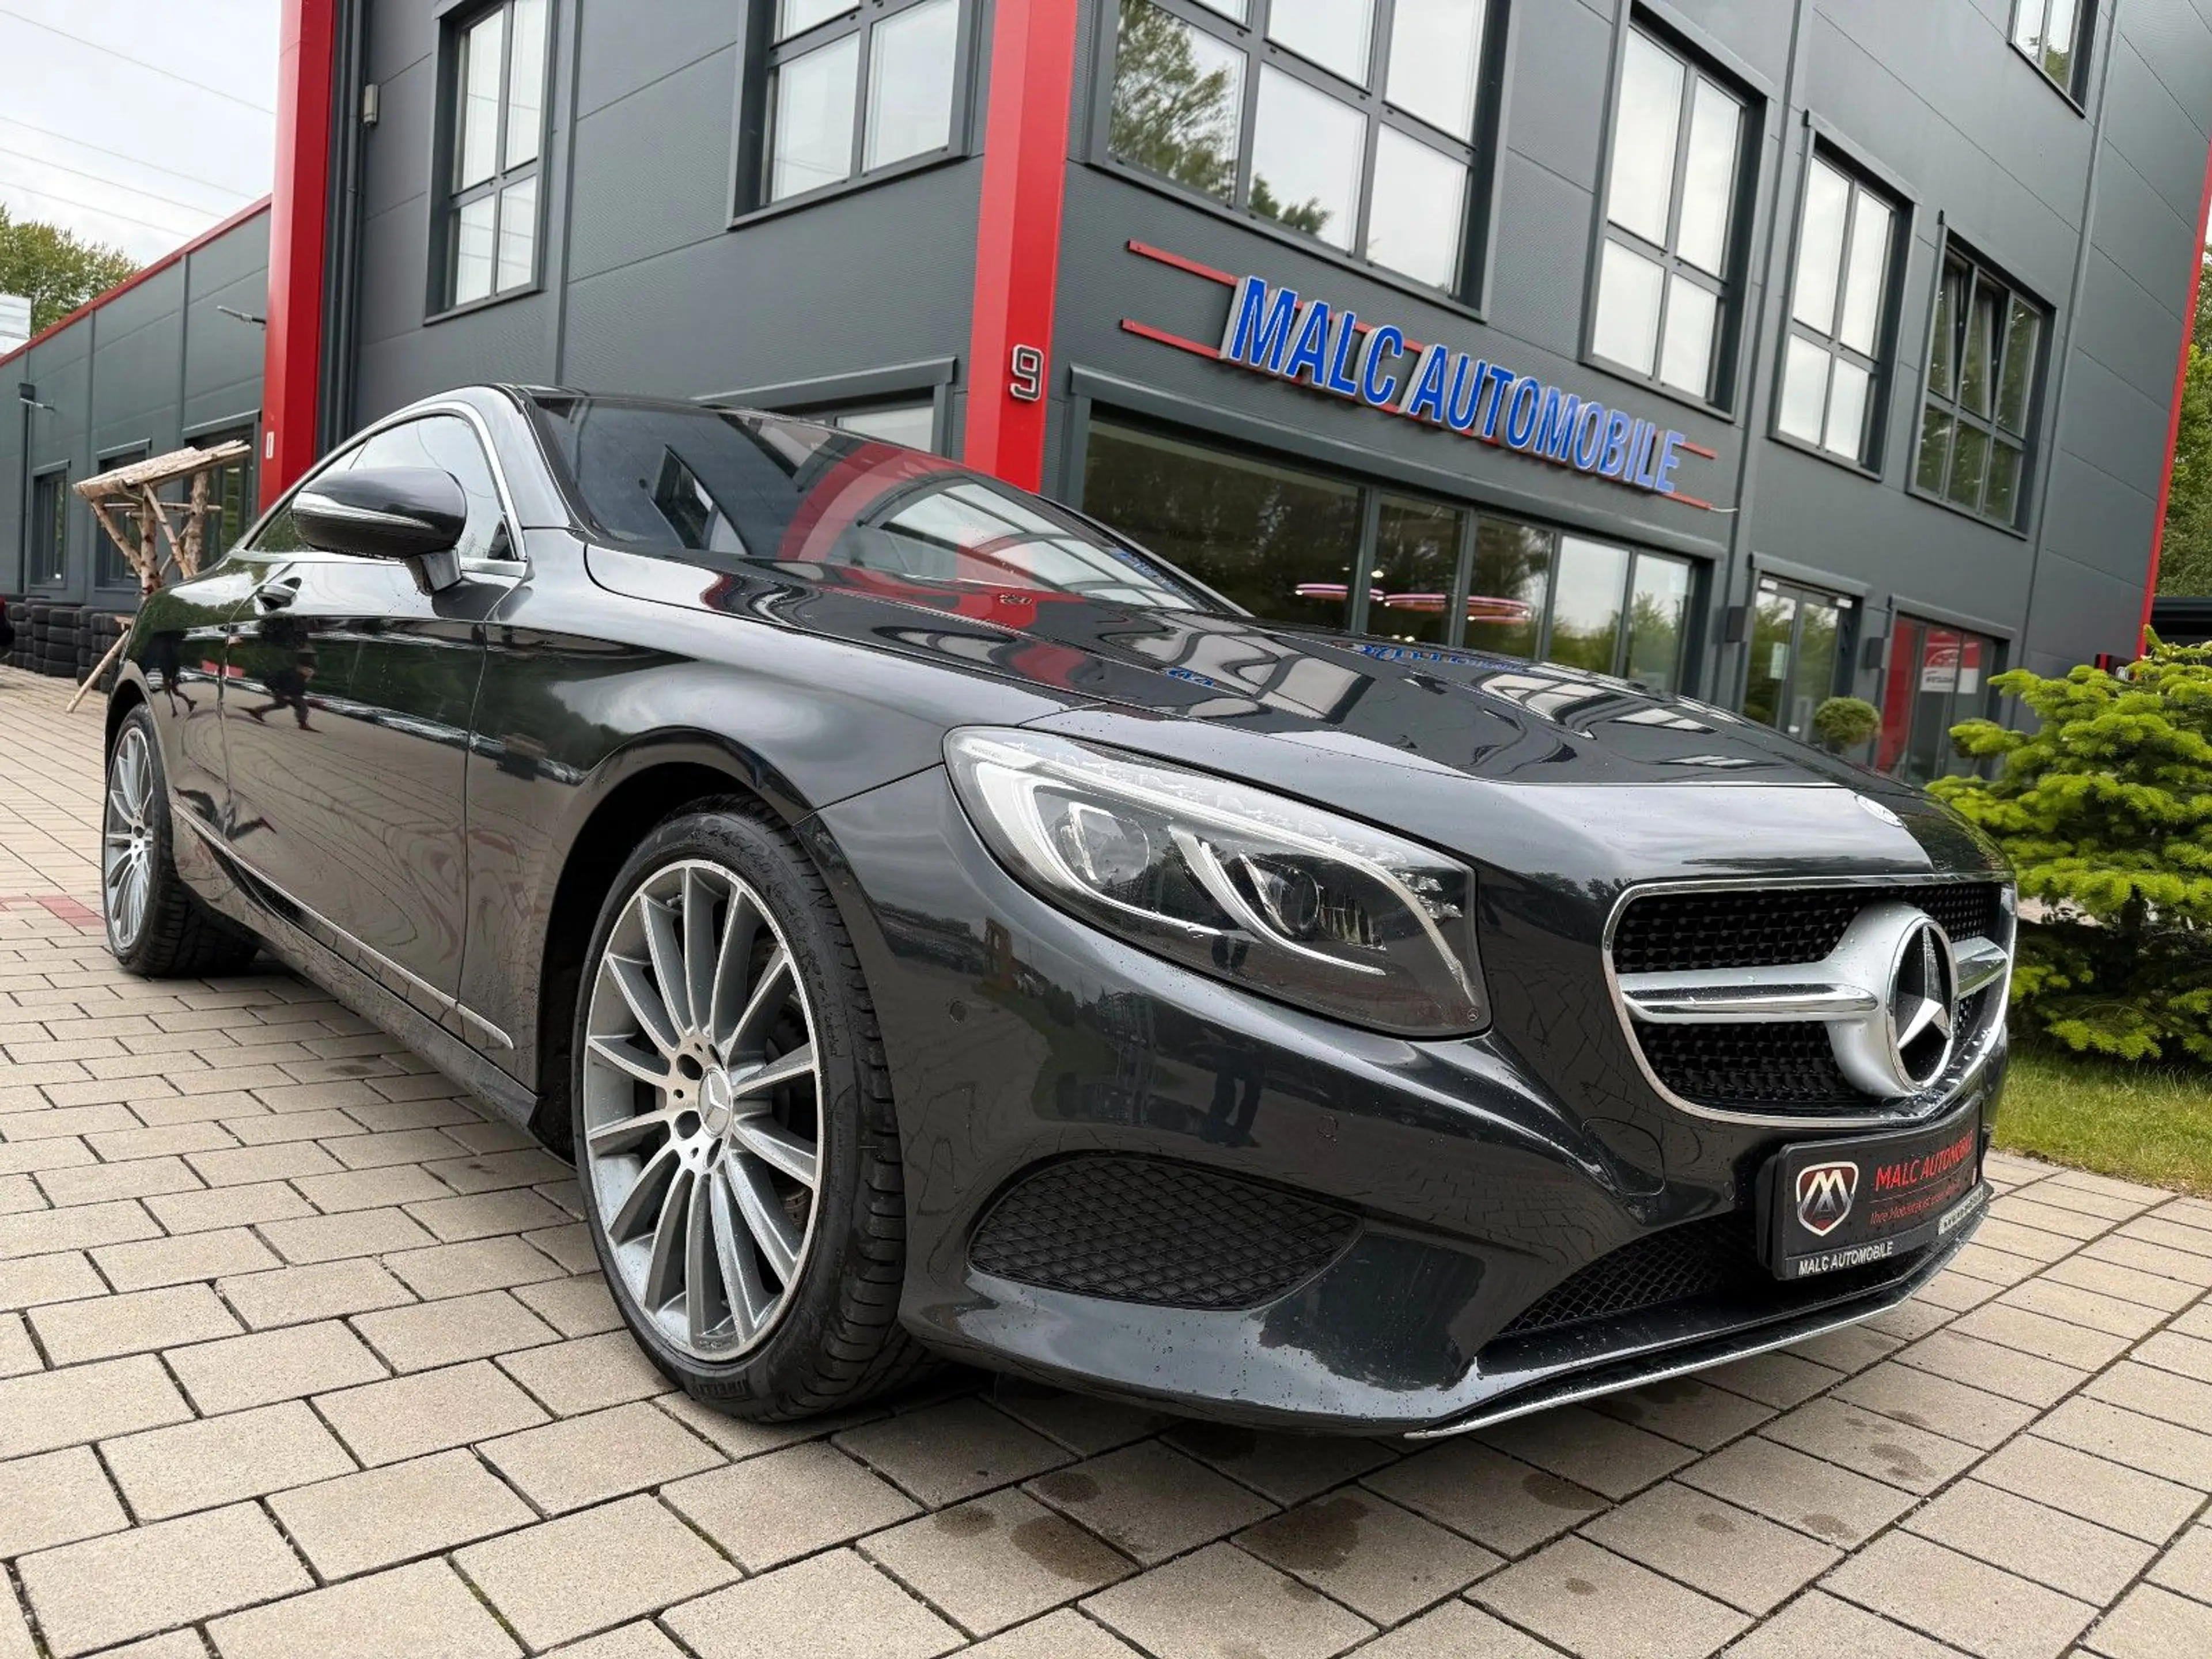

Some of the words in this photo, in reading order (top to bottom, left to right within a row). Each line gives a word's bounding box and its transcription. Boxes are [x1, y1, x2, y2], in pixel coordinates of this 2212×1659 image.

[1010, 343, 1045, 402] 9
[1225, 274, 1406, 407] MALC
[1406, 343, 1687, 494] AUTOMOBILE
[1875, 1160, 1919, 1192] MALC
[1798, 1256, 1829, 1277] MALC
[1830, 1241, 1894, 1271] AUTOMOBILE
